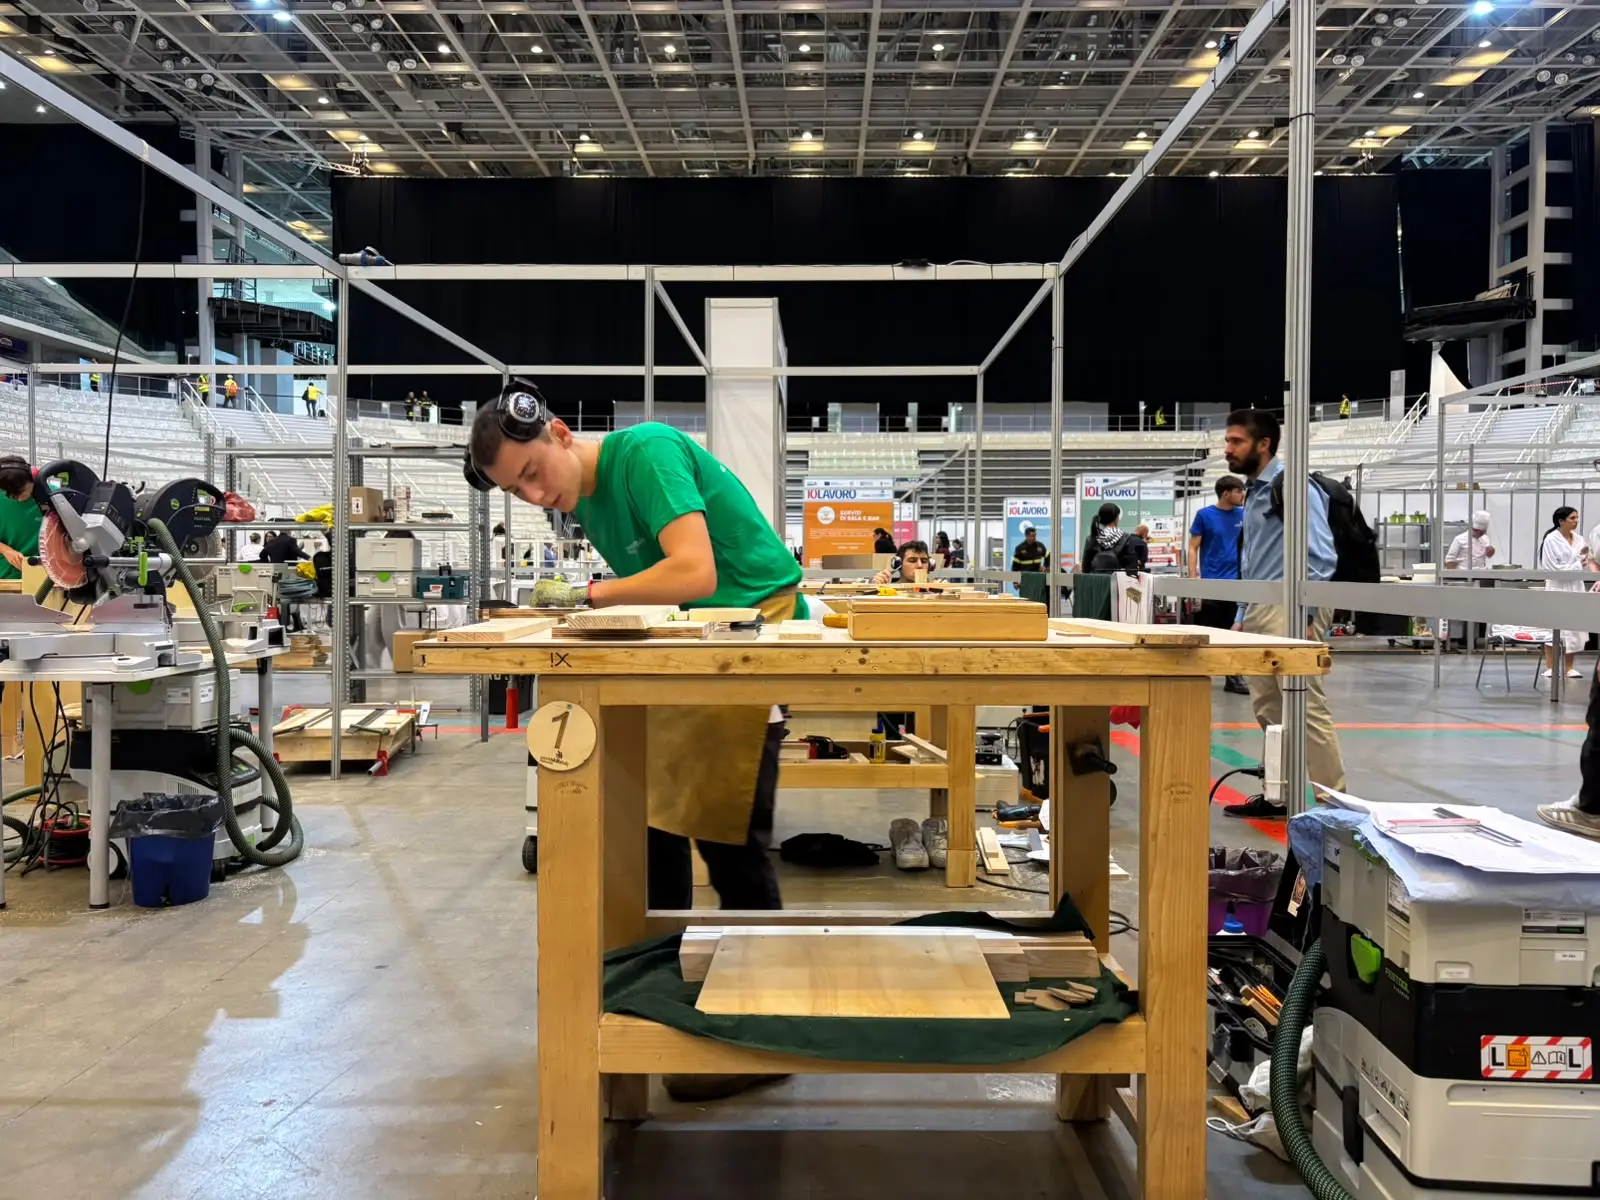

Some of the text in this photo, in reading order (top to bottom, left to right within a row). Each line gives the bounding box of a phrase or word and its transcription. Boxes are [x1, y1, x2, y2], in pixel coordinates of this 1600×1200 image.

[808, 489, 857, 499] IOLAVORO
[1085, 486, 1136, 497] IOLAVORO
[1009, 506, 1048, 515] IOLAVORO
[551, 711, 570, 749] 1
[1491, 1046, 1582, 1068] L L
